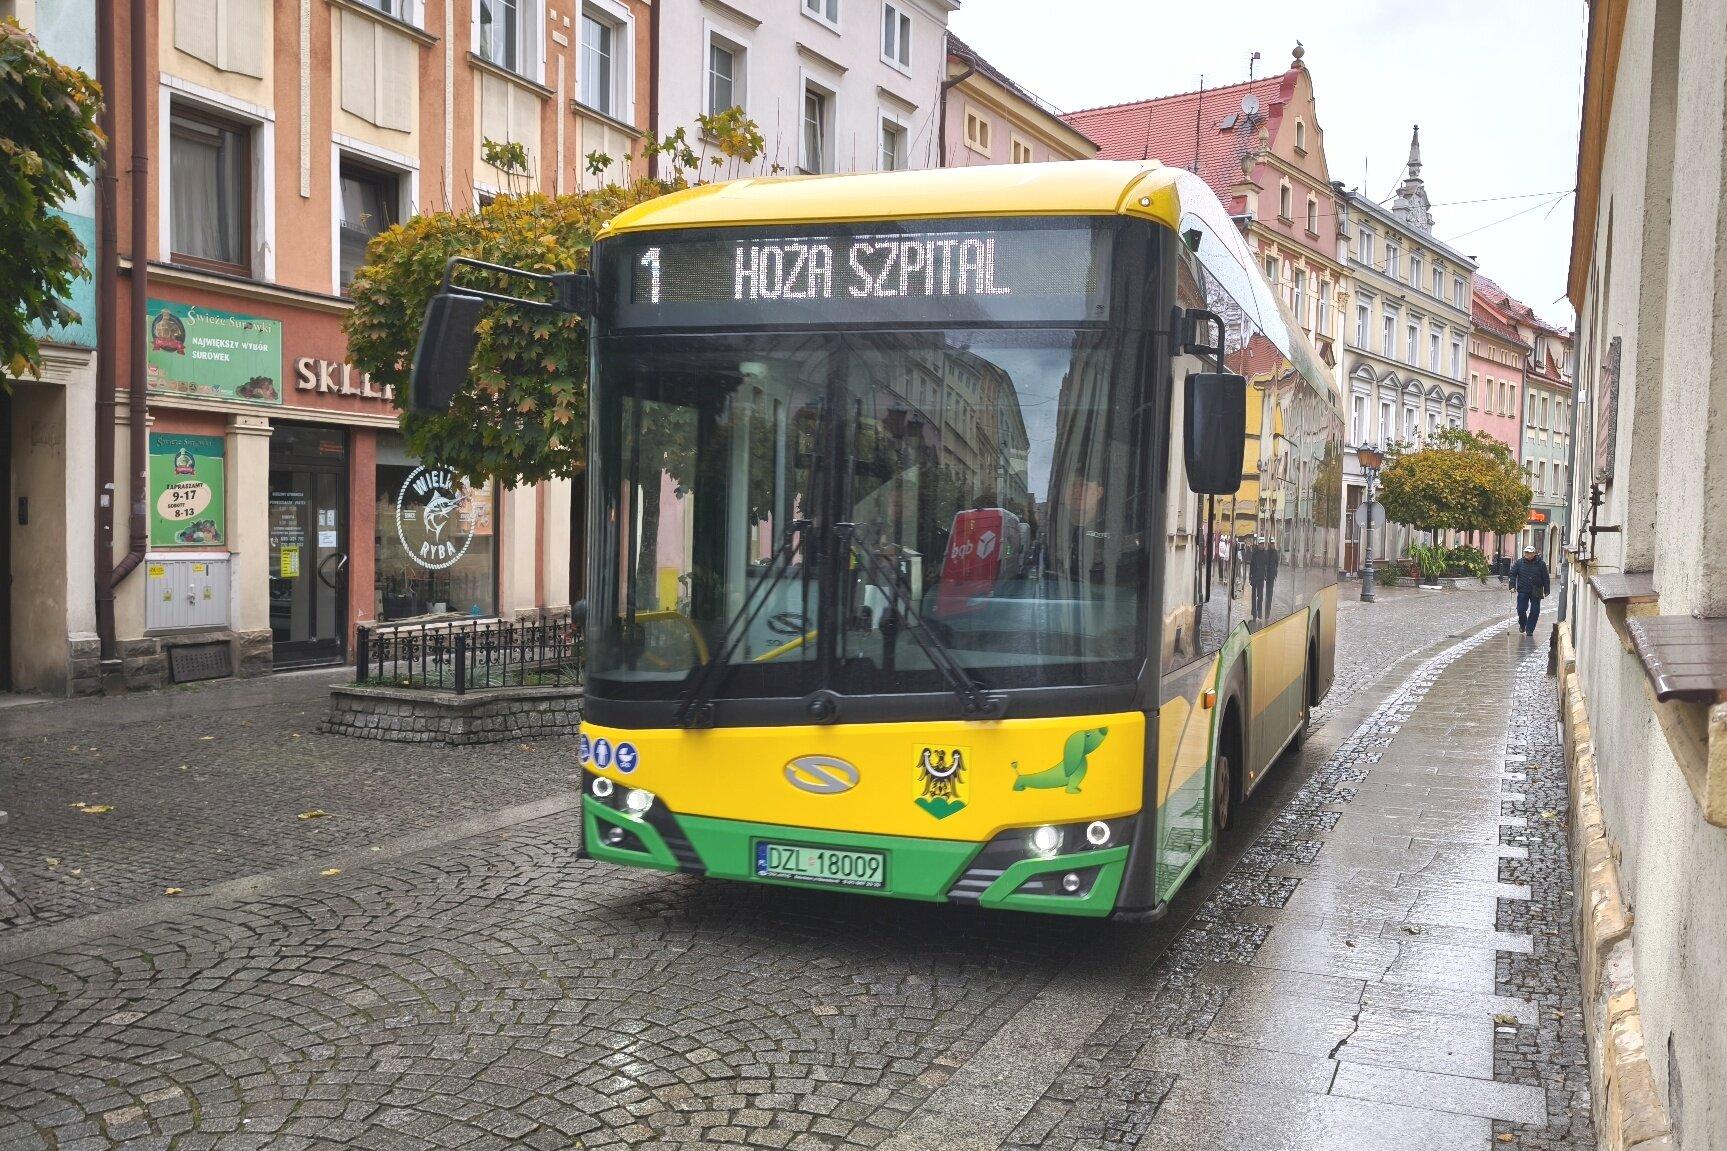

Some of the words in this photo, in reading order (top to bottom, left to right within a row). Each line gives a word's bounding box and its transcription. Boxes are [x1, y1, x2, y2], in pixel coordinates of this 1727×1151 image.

[641, 247, 660, 305] 1
[849, 238, 1011, 297] SZPITAL
[229, 316, 272, 334] Surwki
[192, 337, 240, 350] NAJWIĘKSZY
[192, 348, 230, 362] SURÓWEK
[173, 490, 197, 502] 9-17
[174, 508, 195, 518] 8-13
[419, 541, 456, 560] RYBA
[769, 847, 807, 873] DZL
[817, 851, 881, 880] 18009
